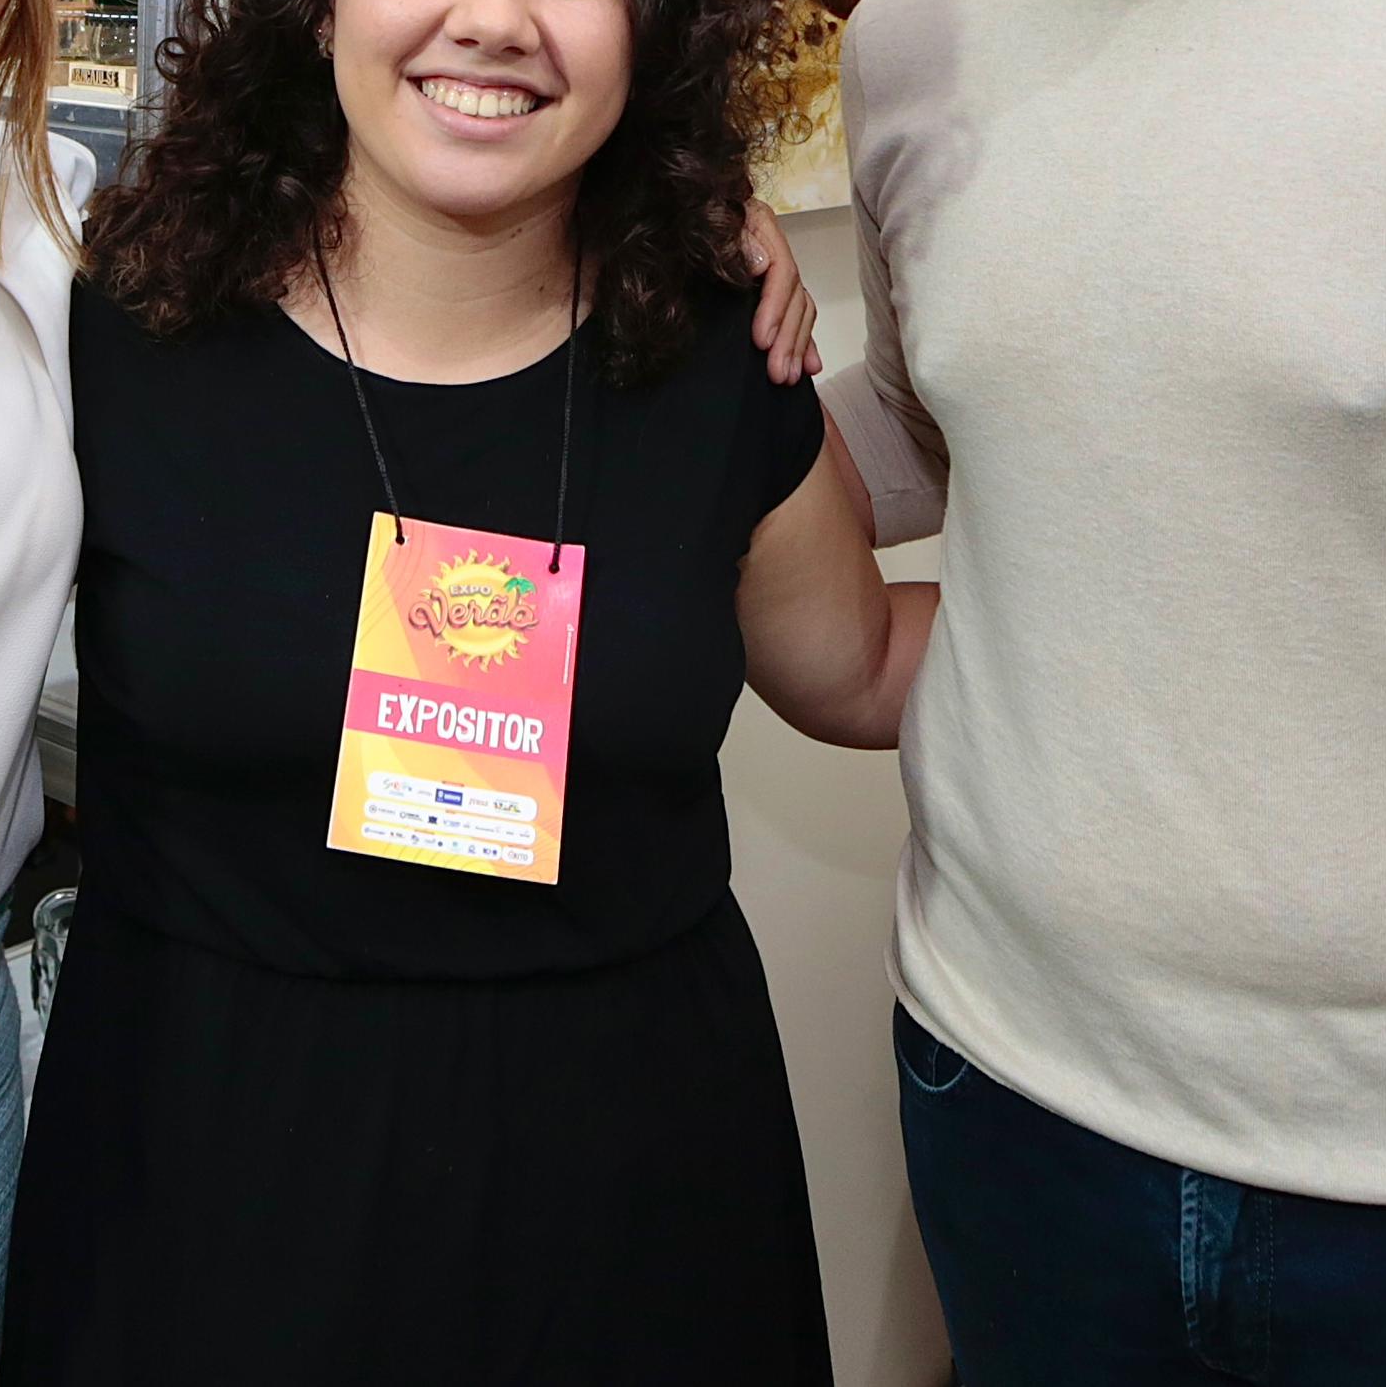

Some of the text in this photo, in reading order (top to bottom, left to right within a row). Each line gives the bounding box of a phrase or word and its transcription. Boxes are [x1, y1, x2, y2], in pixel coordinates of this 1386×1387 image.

[409, 586, 541, 635] Verão
[449, 583, 493, 597] EXPO
[376, 691, 544, 754] EXPOSITOR
